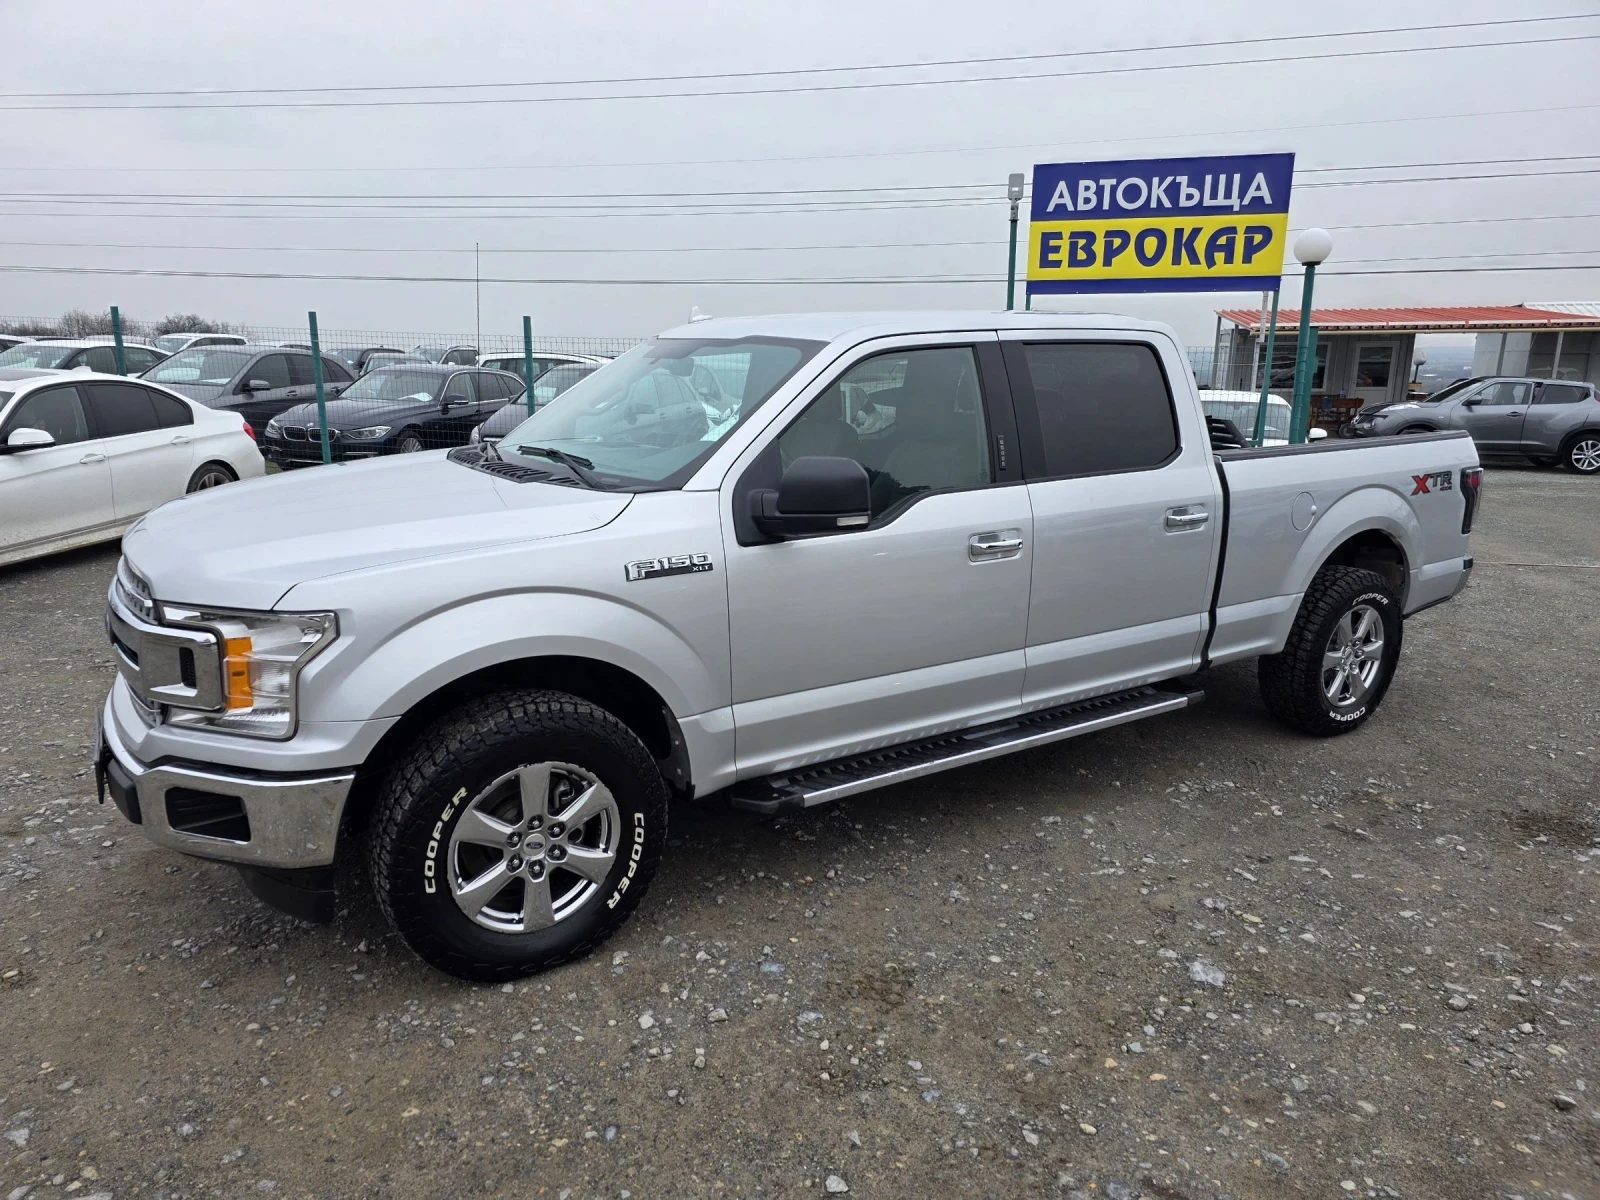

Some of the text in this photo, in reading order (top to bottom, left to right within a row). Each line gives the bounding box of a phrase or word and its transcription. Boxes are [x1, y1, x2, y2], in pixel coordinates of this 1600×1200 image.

[1046, 172, 1273, 212] АВТОКЪЩА
[1039, 225, 1273, 270] ЕВРОКАР
[1410, 471, 1452, 496] XTR
[692, 564, 710, 572] XLT
[1352, 592, 1389, 605] COOPER
[1329, 706, 1366, 721] COOPER
[424, 786, 468, 893] COOPER
[606, 812, 644, 909] COOPER
